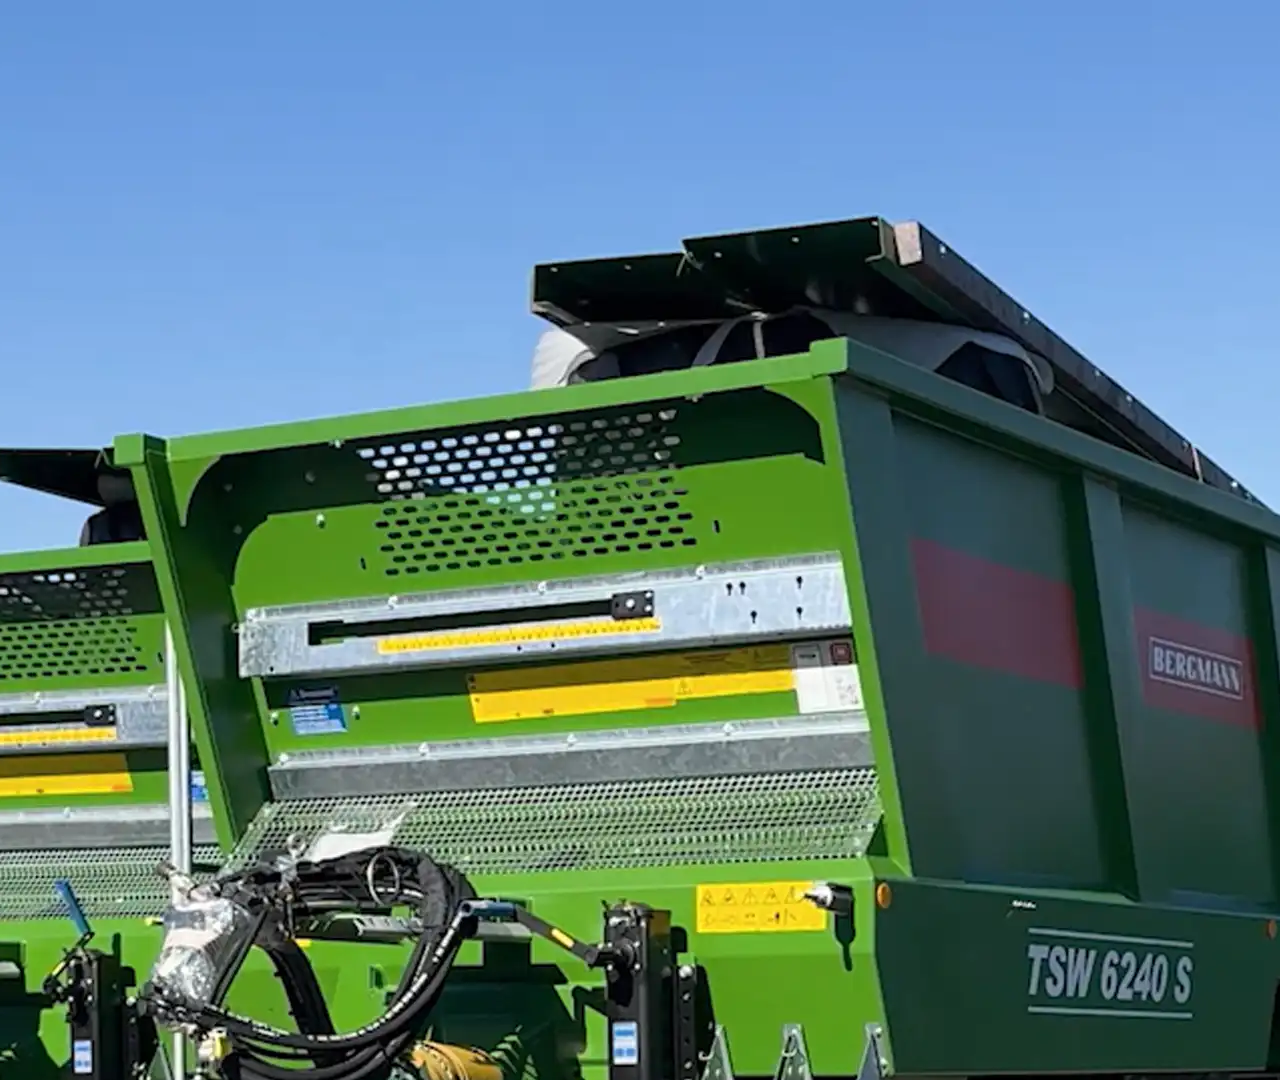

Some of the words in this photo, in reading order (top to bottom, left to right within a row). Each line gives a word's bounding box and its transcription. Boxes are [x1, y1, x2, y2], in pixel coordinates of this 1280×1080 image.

[1153, 646, 1240, 692] BERGMANN
[1028, 944, 1097, 998] TSW
[1100, 950, 1169, 1003] 6240
[1174, 956, 1194, 1004] S
